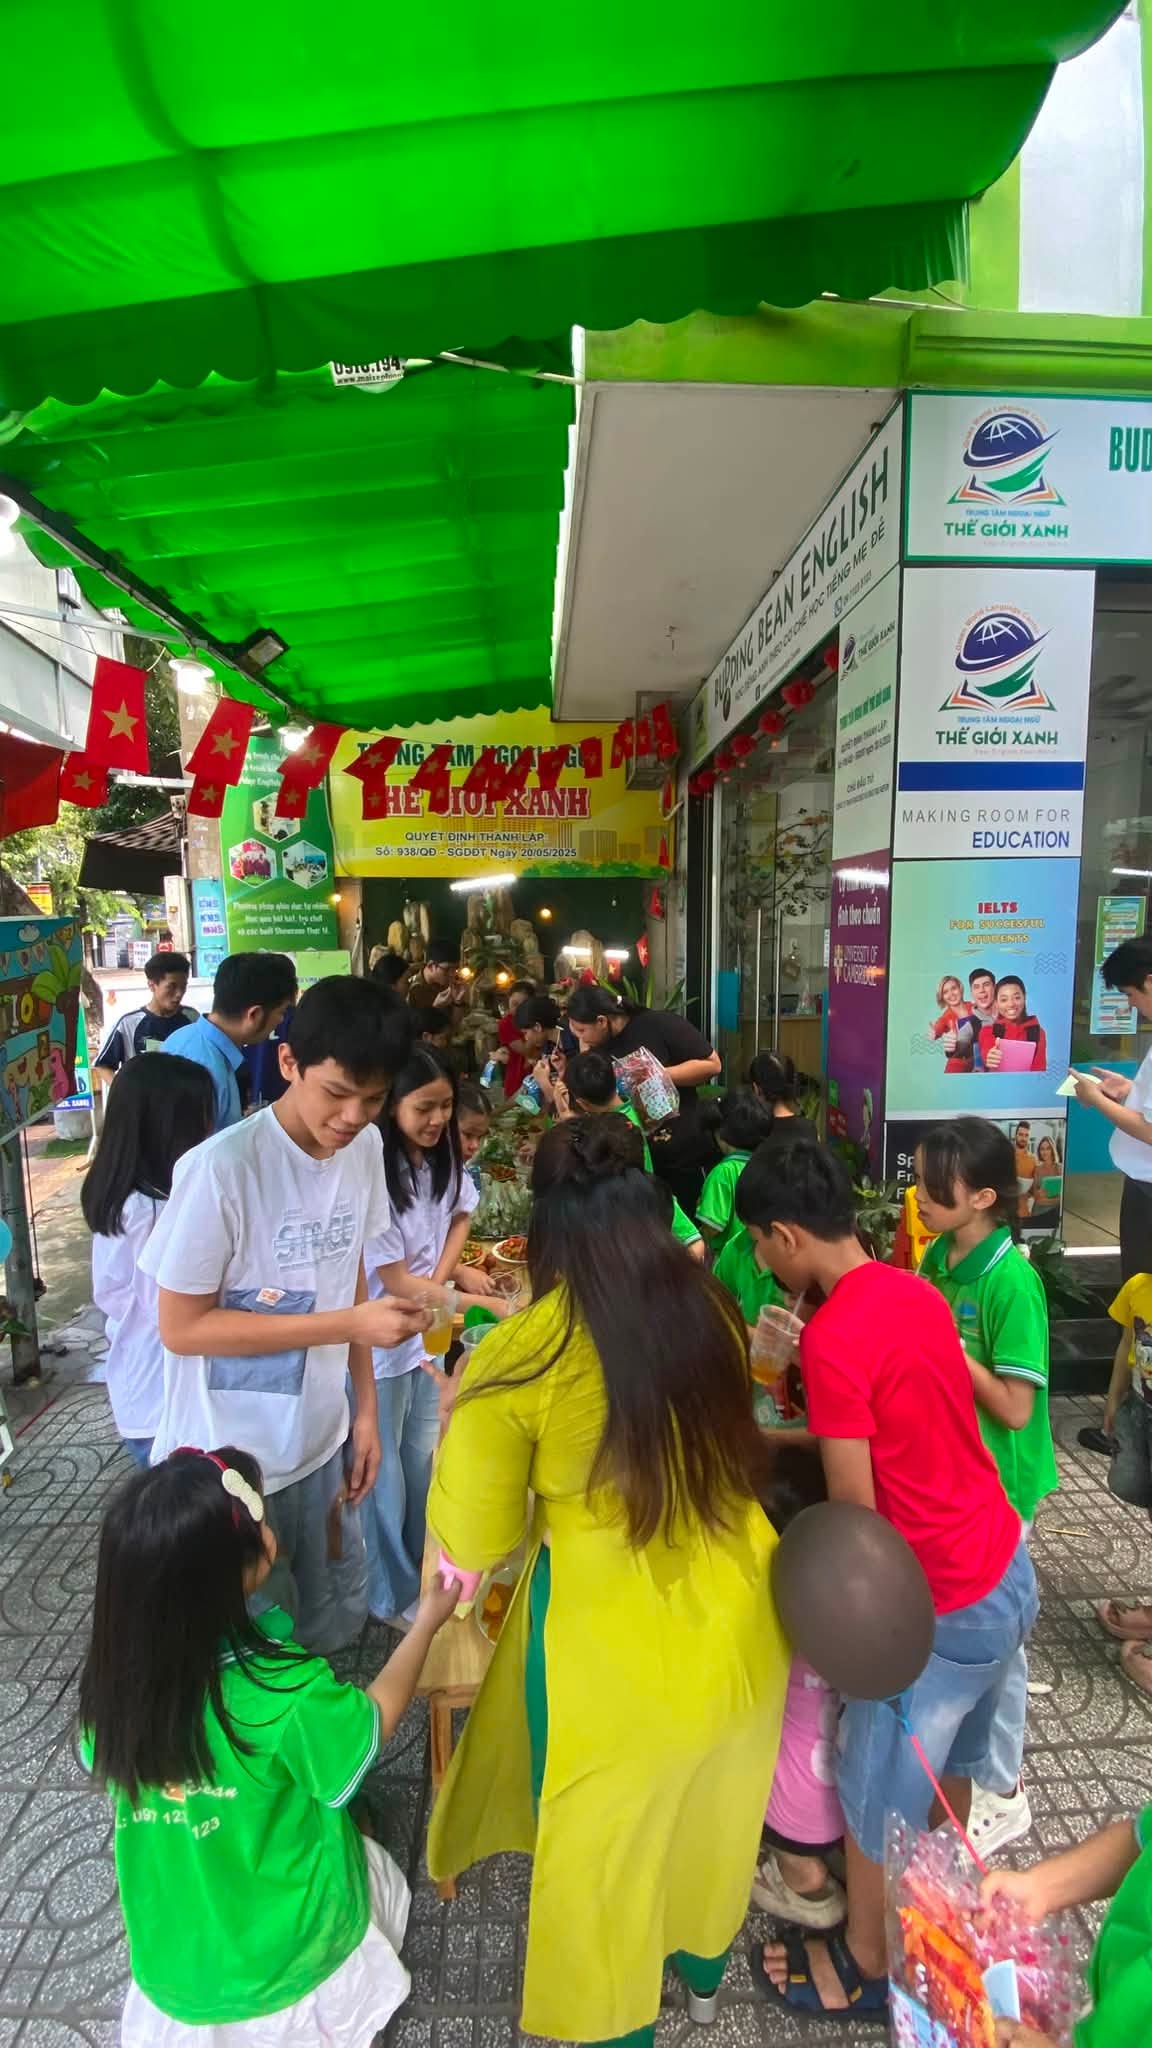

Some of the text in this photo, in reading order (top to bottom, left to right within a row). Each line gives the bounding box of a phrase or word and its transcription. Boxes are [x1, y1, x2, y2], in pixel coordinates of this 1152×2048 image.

[944, 519, 1069, 538] THẾ GIỚI XANH
[758, 573, 794, 656] BEAN
[801, 445, 888, 602] ENGLISH
[936, 726, 1059, 745] THẾ GIỚI XANH
[505, 788, 589, 816] XANH
[902, 808, 1070, 823] MAKING ROOM FOR
[405, 829, 444, 841] QUYẾT
[448, 832, 476, 842] ĐỊNH
[972, 831, 1070, 849] EDUCATION
[375, 845, 394, 856] Số:
[397, 847, 436, 856] 938/QĐ
[490, 847, 518, 859] Ngày
[521, 848, 577, 857] 20/05/2025
[978, 901, 1018, 914] IELTS
[950, 919, 974, 930] FOR
[967, 933, 1030, 944] STUDENTS
[870, 945, 879, 963] OF
